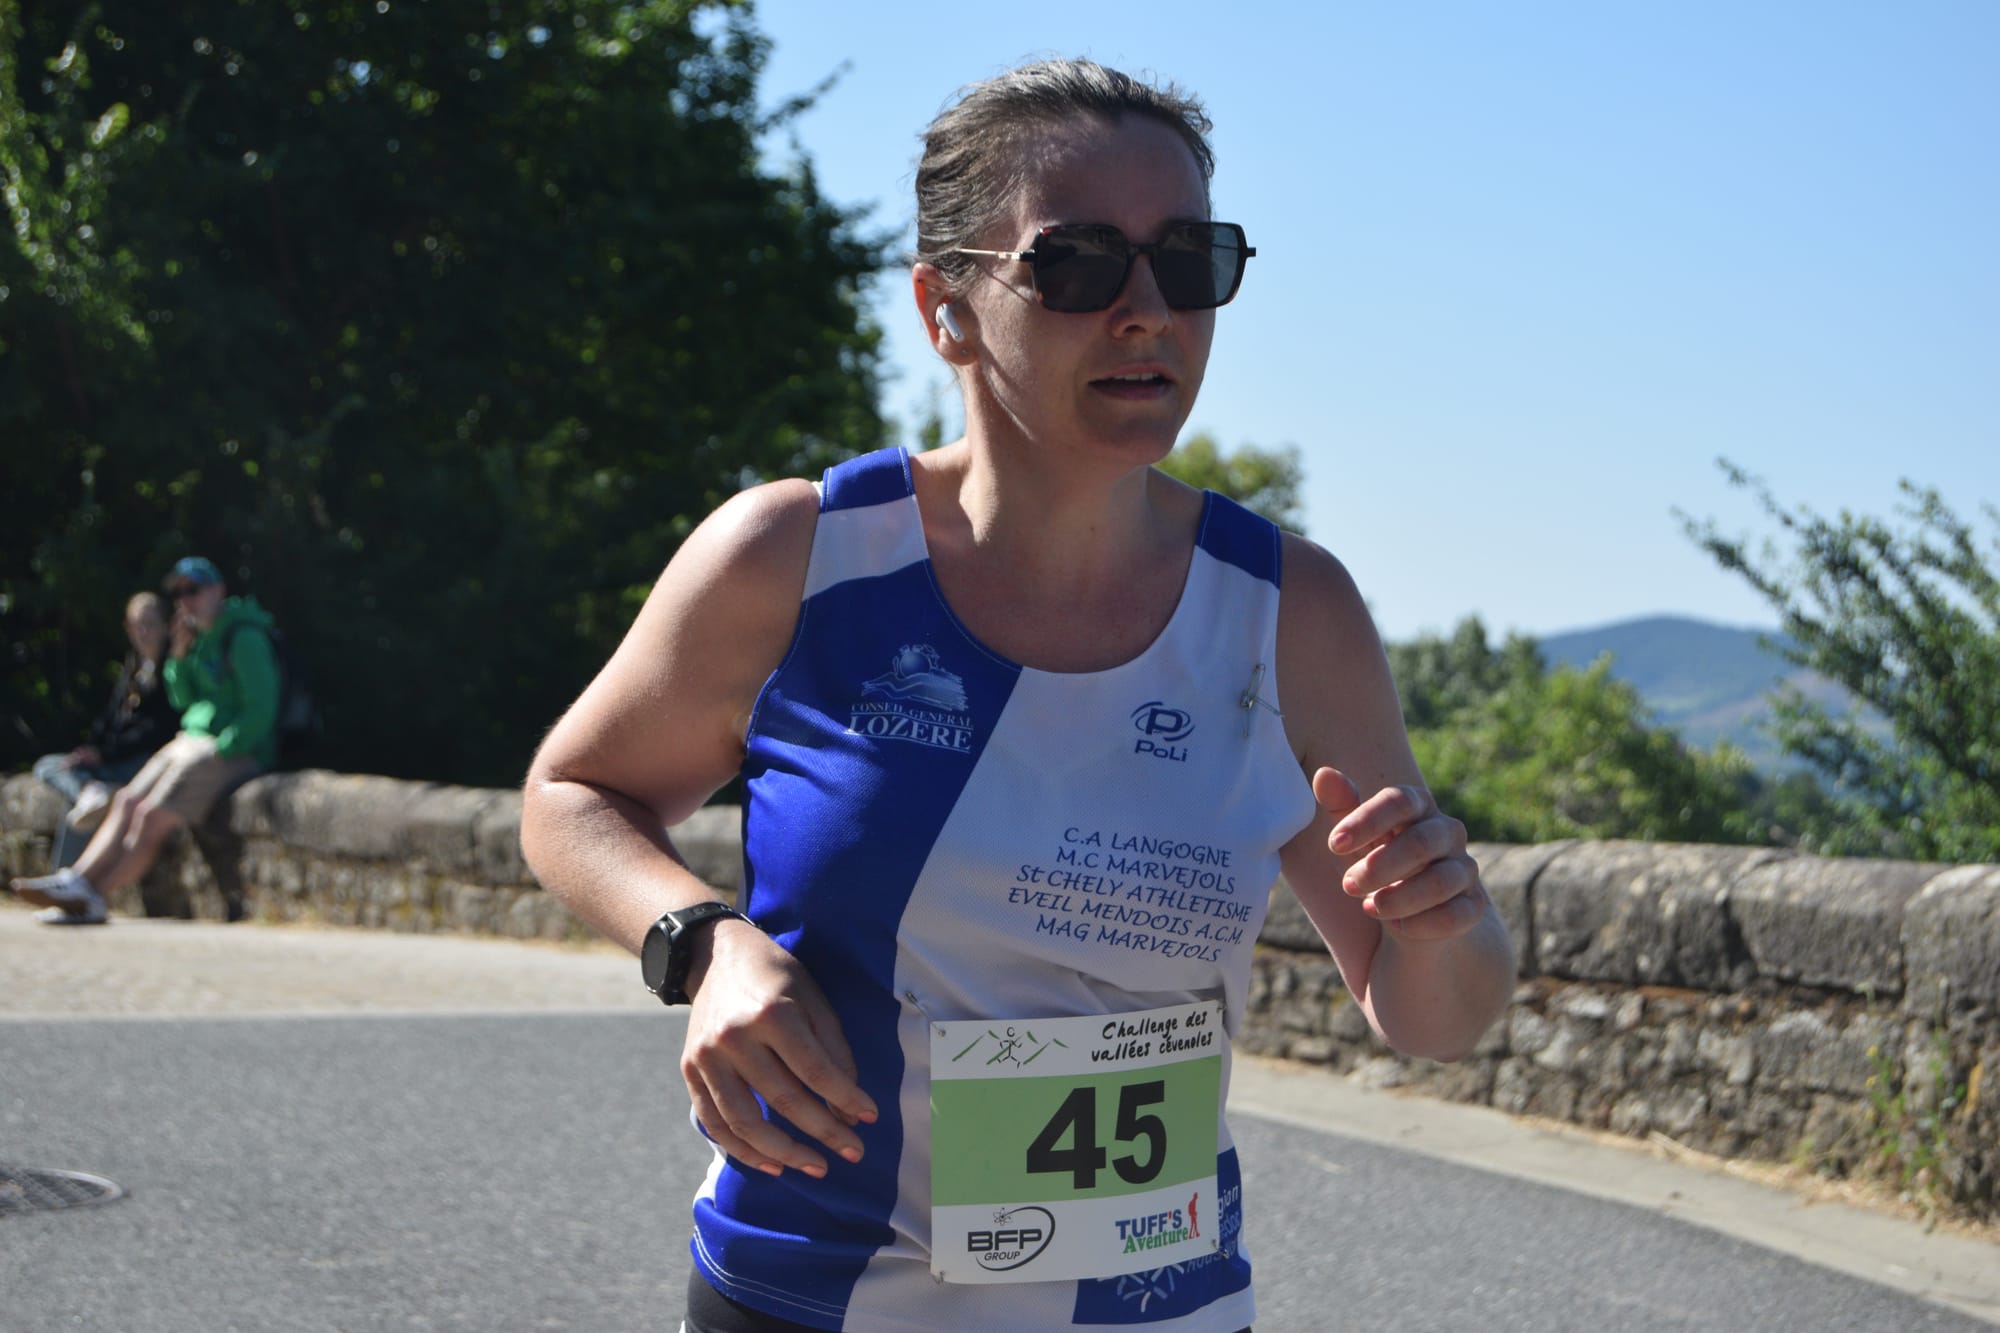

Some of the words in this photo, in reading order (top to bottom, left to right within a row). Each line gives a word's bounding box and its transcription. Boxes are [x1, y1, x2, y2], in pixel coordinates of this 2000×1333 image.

[849, 715, 972, 751] LOZERE
[1064, 827, 1101, 847] C.A
[1111, 833, 1232, 868] LANGOGNE
[1056, 847, 1099, 868] M.C
[1106, 854, 1235, 894] MARVEJOLS
[1008, 887, 1074, 913] EVEIL
[1080, 899, 1192, 936] MENDOIS
[1016, 864, 1044, 884] St
[1047, 870, 1123, 897] CHELY
[1127, 885, 1252, 923] ATHLETISME
[1035, 914, 1091, 942] MAG
[1097, 926, 1222, 962] MARVEJOLS
[1102, 1017, 1178, 1039] Challenge
[1186, 1011, 1208, 1028] des
[1091, 1040, 1151, 1062] vallées
[1159, 1031, 1213, 1054] cévenoles
[1026, 1079, 1167, 1190] 45
[967, 1228, 1042, 1252] BFP
[1115, 1209, 1183, 1240] TUFF'S
[1122, 1227, 1188, 1254] Aventure
[984, 1250, 1021, 1262] GROUP
